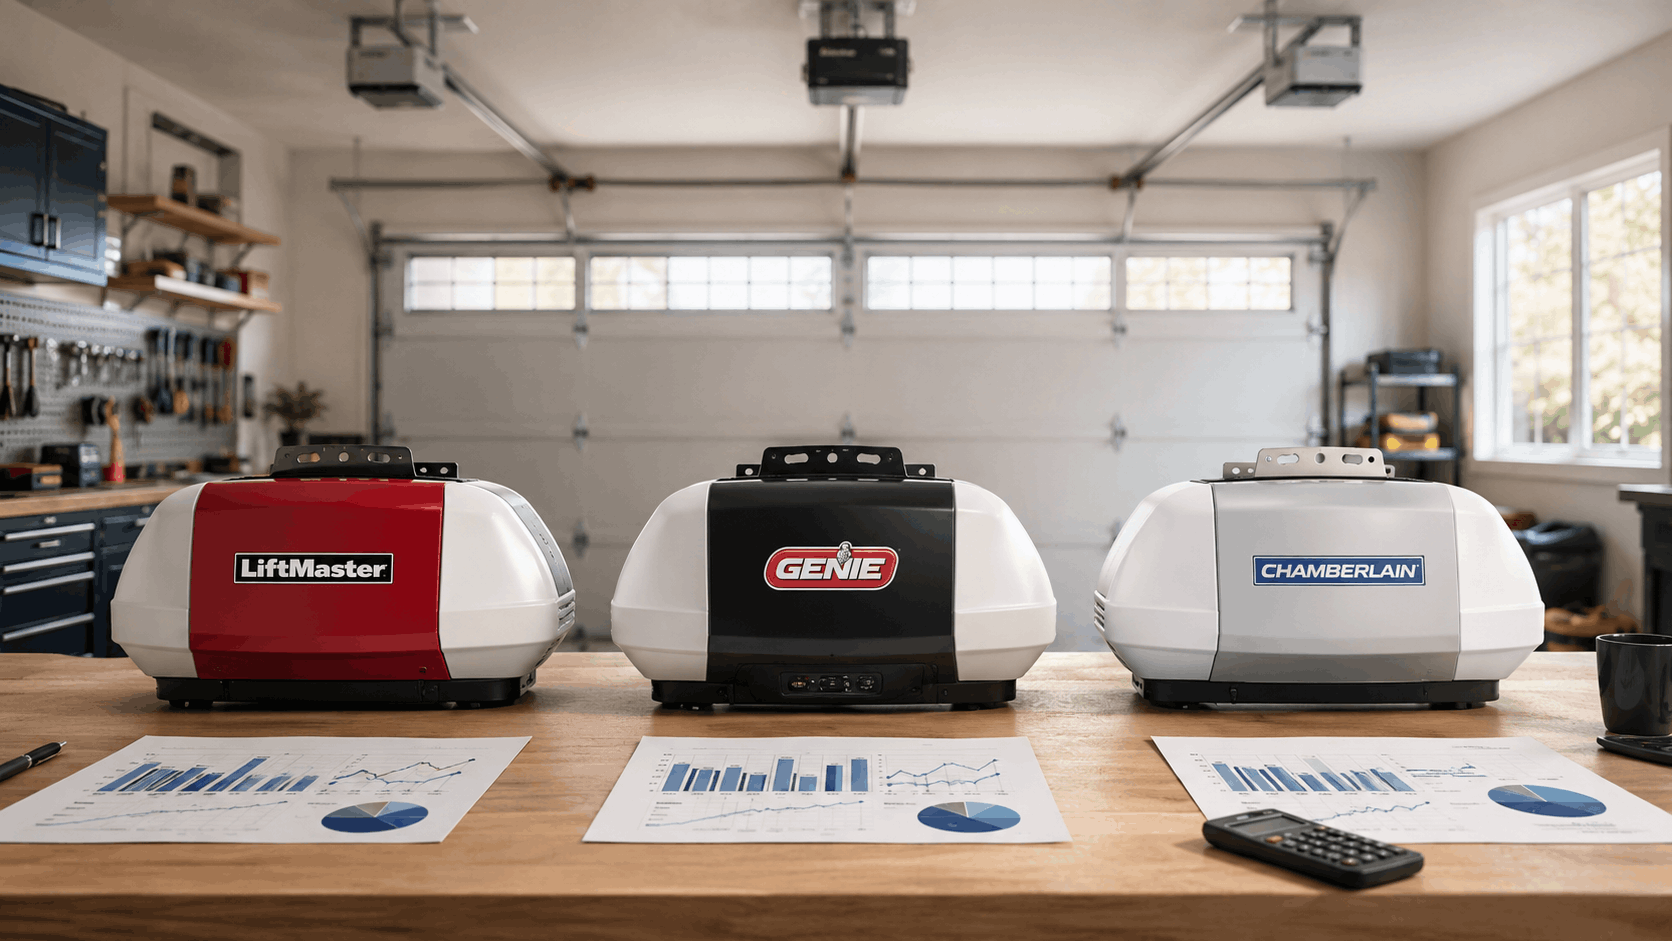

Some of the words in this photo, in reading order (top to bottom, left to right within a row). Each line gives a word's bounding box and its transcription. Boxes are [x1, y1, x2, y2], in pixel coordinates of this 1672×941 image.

[241, 558, 388, 578] LiftMaster
[776, 558, 887, 580] GENIE
[1261, 564, 1416, 578] CHAMBERLAIN
